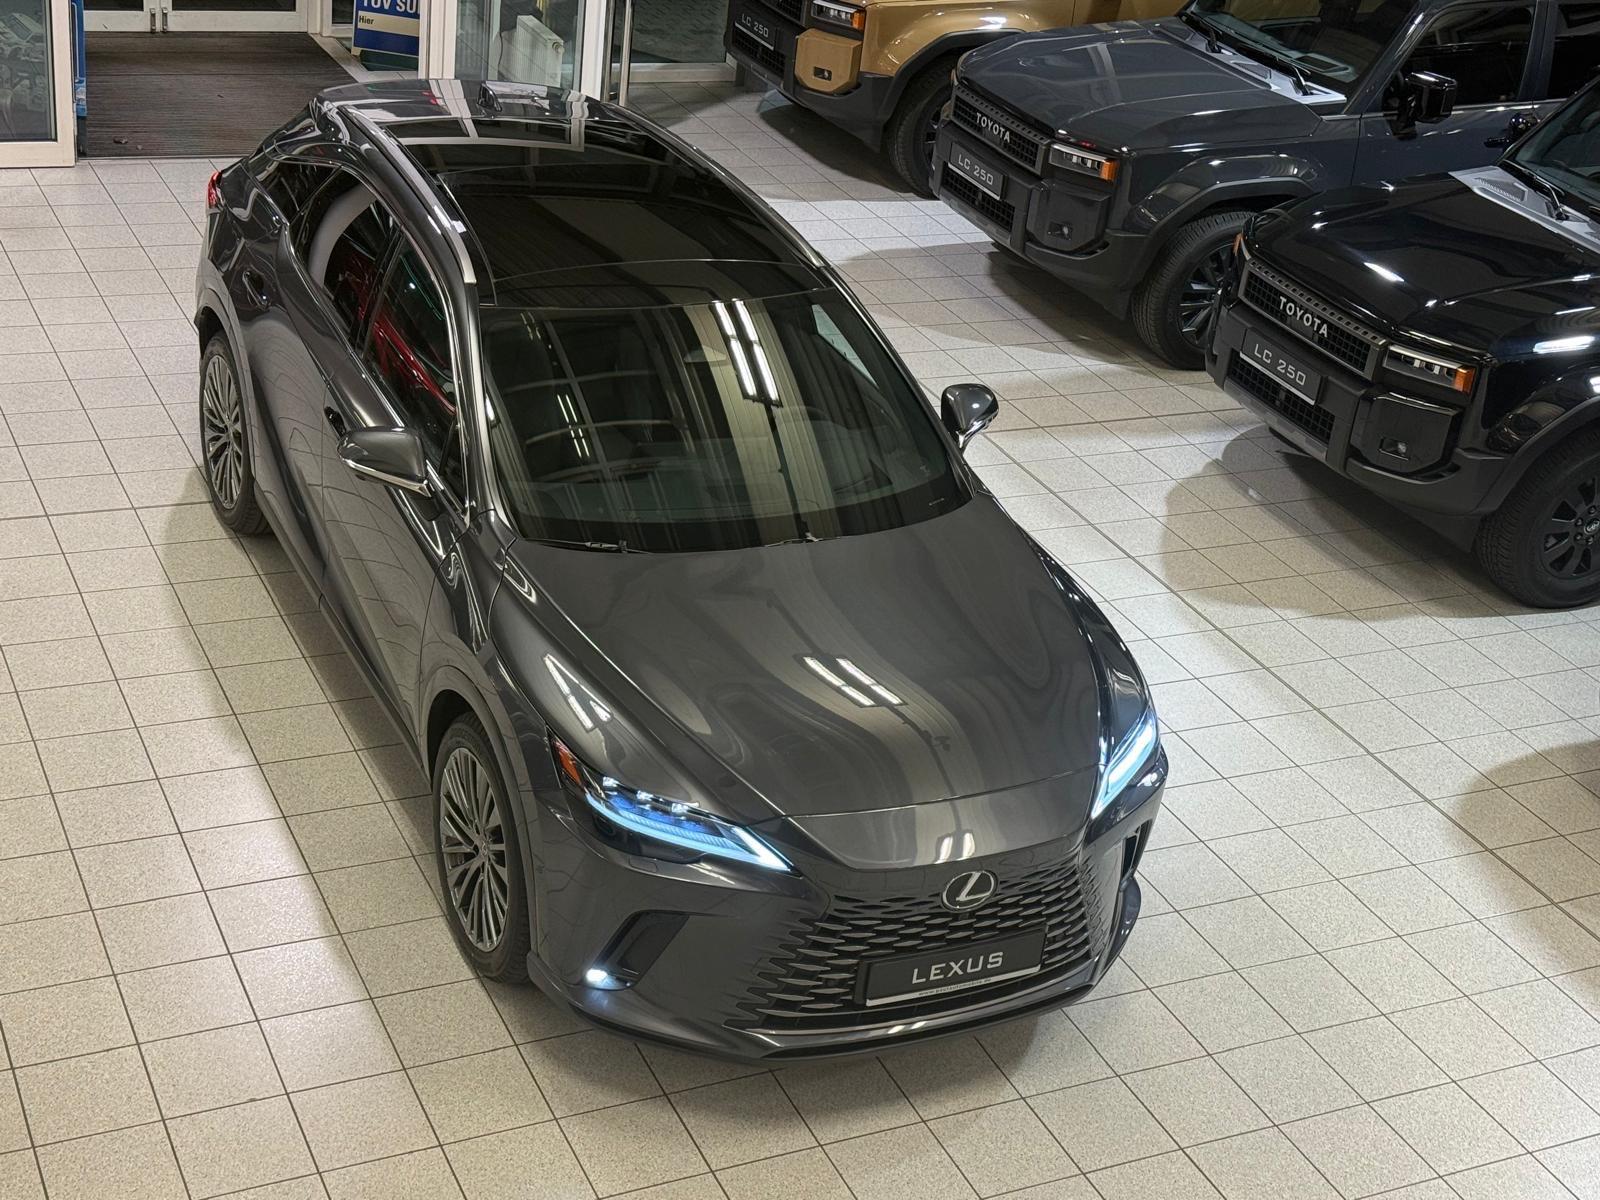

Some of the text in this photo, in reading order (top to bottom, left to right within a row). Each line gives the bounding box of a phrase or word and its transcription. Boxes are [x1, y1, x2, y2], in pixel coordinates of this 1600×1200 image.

[359, 15, 375, 25] Hier
[754, 21, 769, 38] 250
[976, 112, 1011, 143] TOYOTA
[958, 154, 994, 186] LC 250
[1279, 296, 1328, 338] TOYOTA
[1254, 343, 1307, 386] LC 250
[912, 952, 1004, 985] LEXUS
